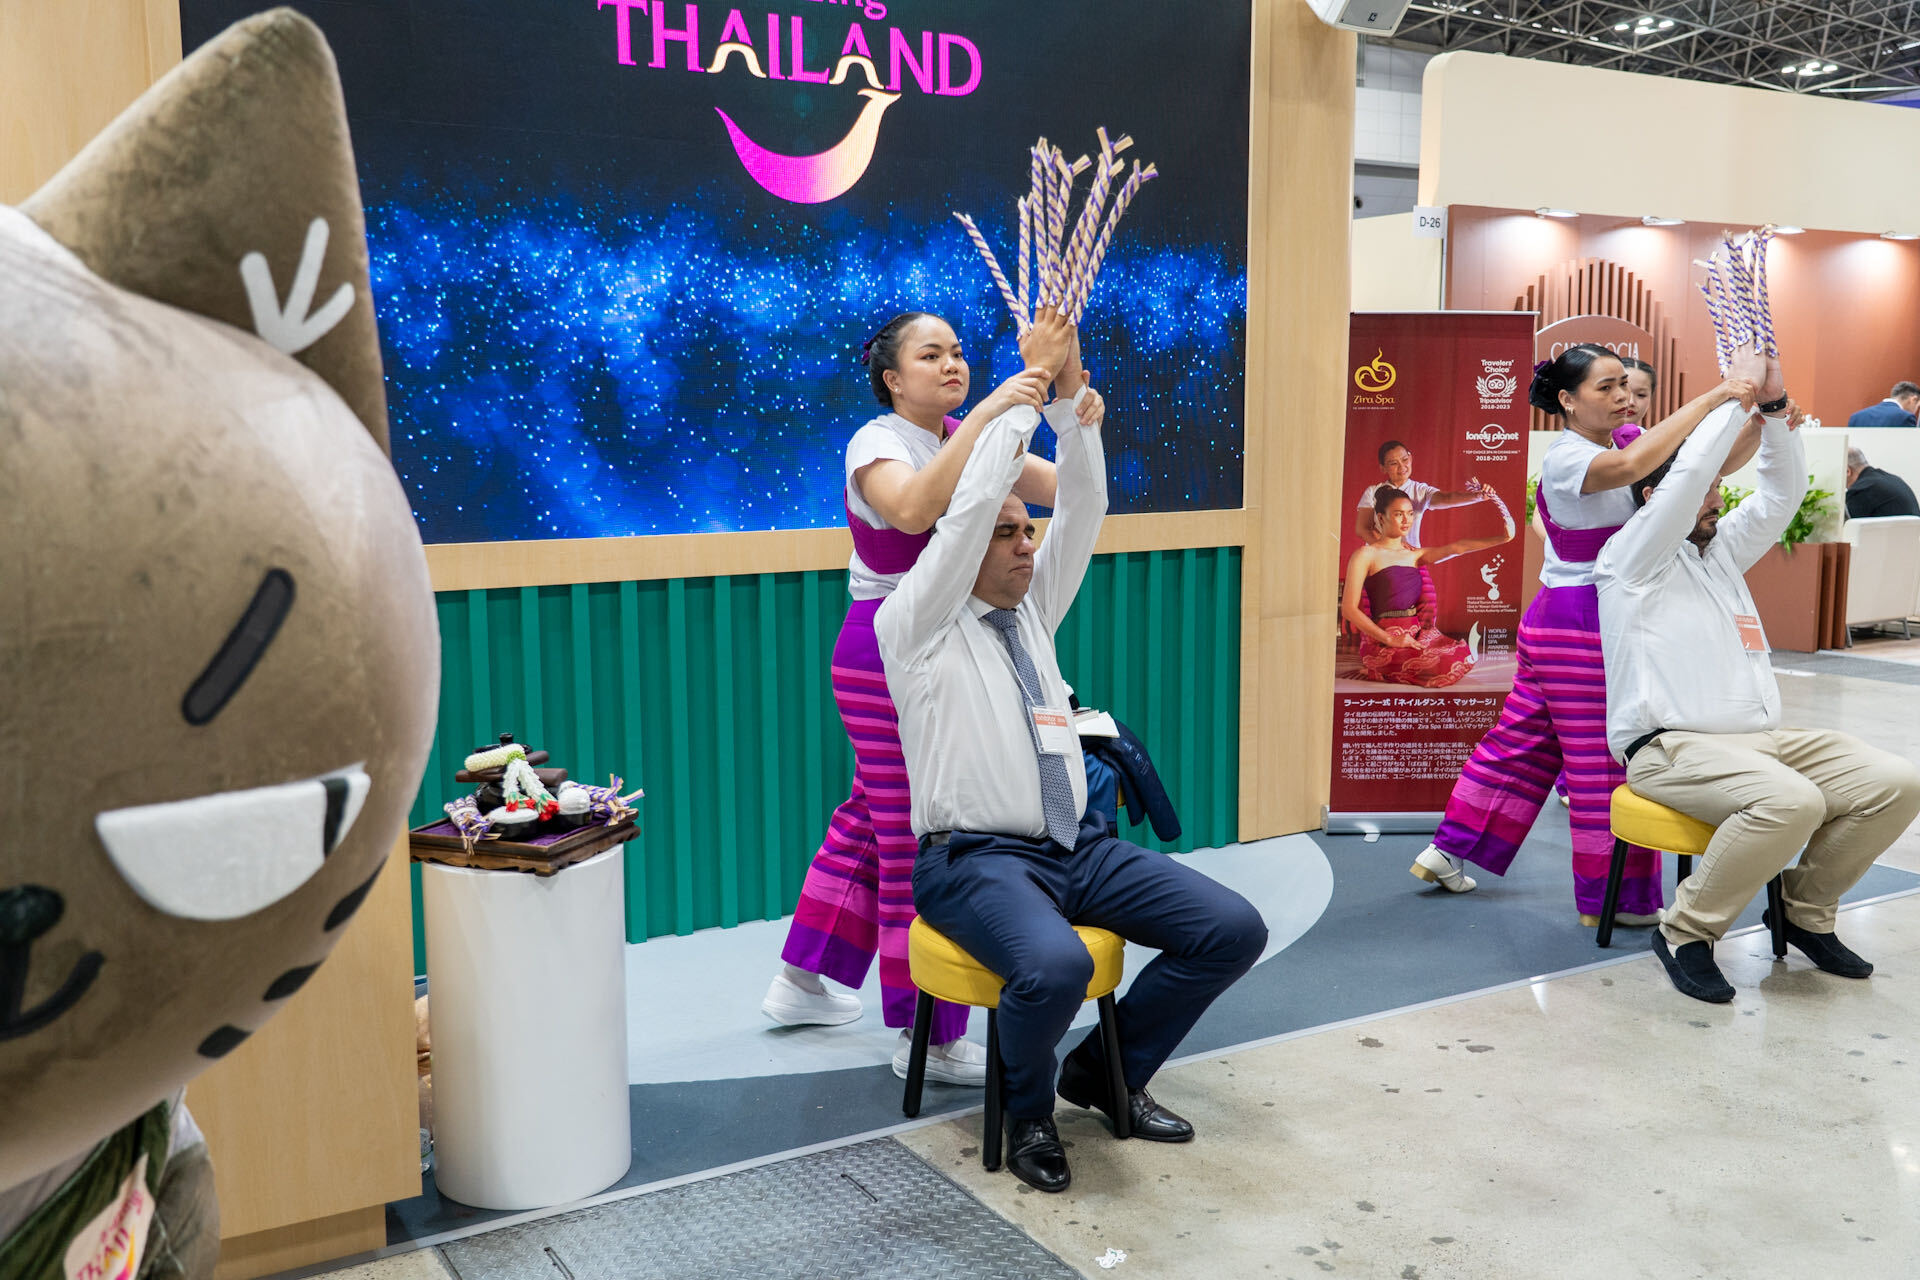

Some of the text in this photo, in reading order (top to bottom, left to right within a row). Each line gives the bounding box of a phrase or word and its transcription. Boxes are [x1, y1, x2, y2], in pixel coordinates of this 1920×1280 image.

[597, 0, 982, 97] THAILAND
[1420, 216, 1441, 229] D-26
[1484, 366, 1510, 374] Choice
[1353, 393, 1395, 406] Zira Spa
[1479, 397, 1513, 405] Tripadvisor
[1466, 430, 1519, 443] lonely planet
